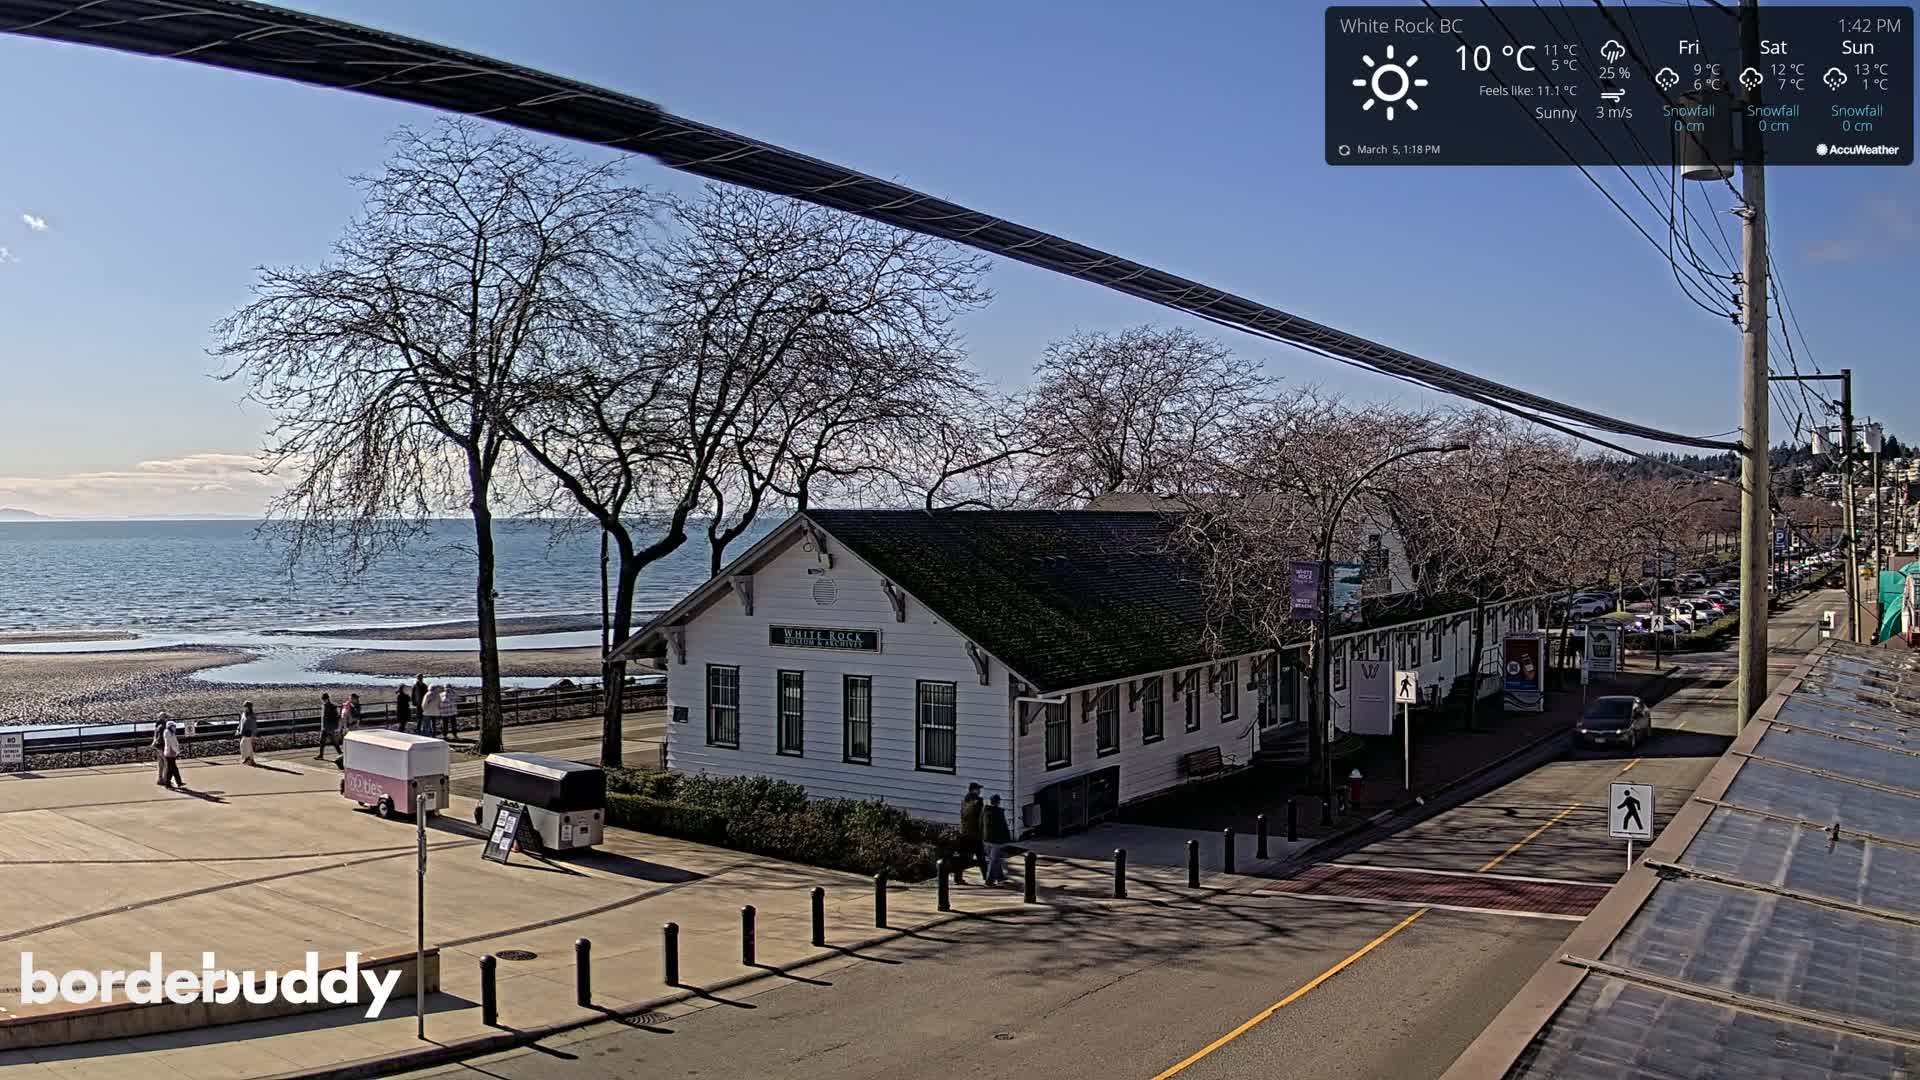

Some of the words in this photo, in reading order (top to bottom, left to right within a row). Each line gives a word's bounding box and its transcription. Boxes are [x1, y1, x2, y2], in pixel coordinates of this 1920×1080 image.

[784, 628, 822, 639] WHITE
[829, 631, 862, 641] ROCK
[784, 638, 815, 646] MUSEUM
[824, 640, 863, 649] ARCHIVES
